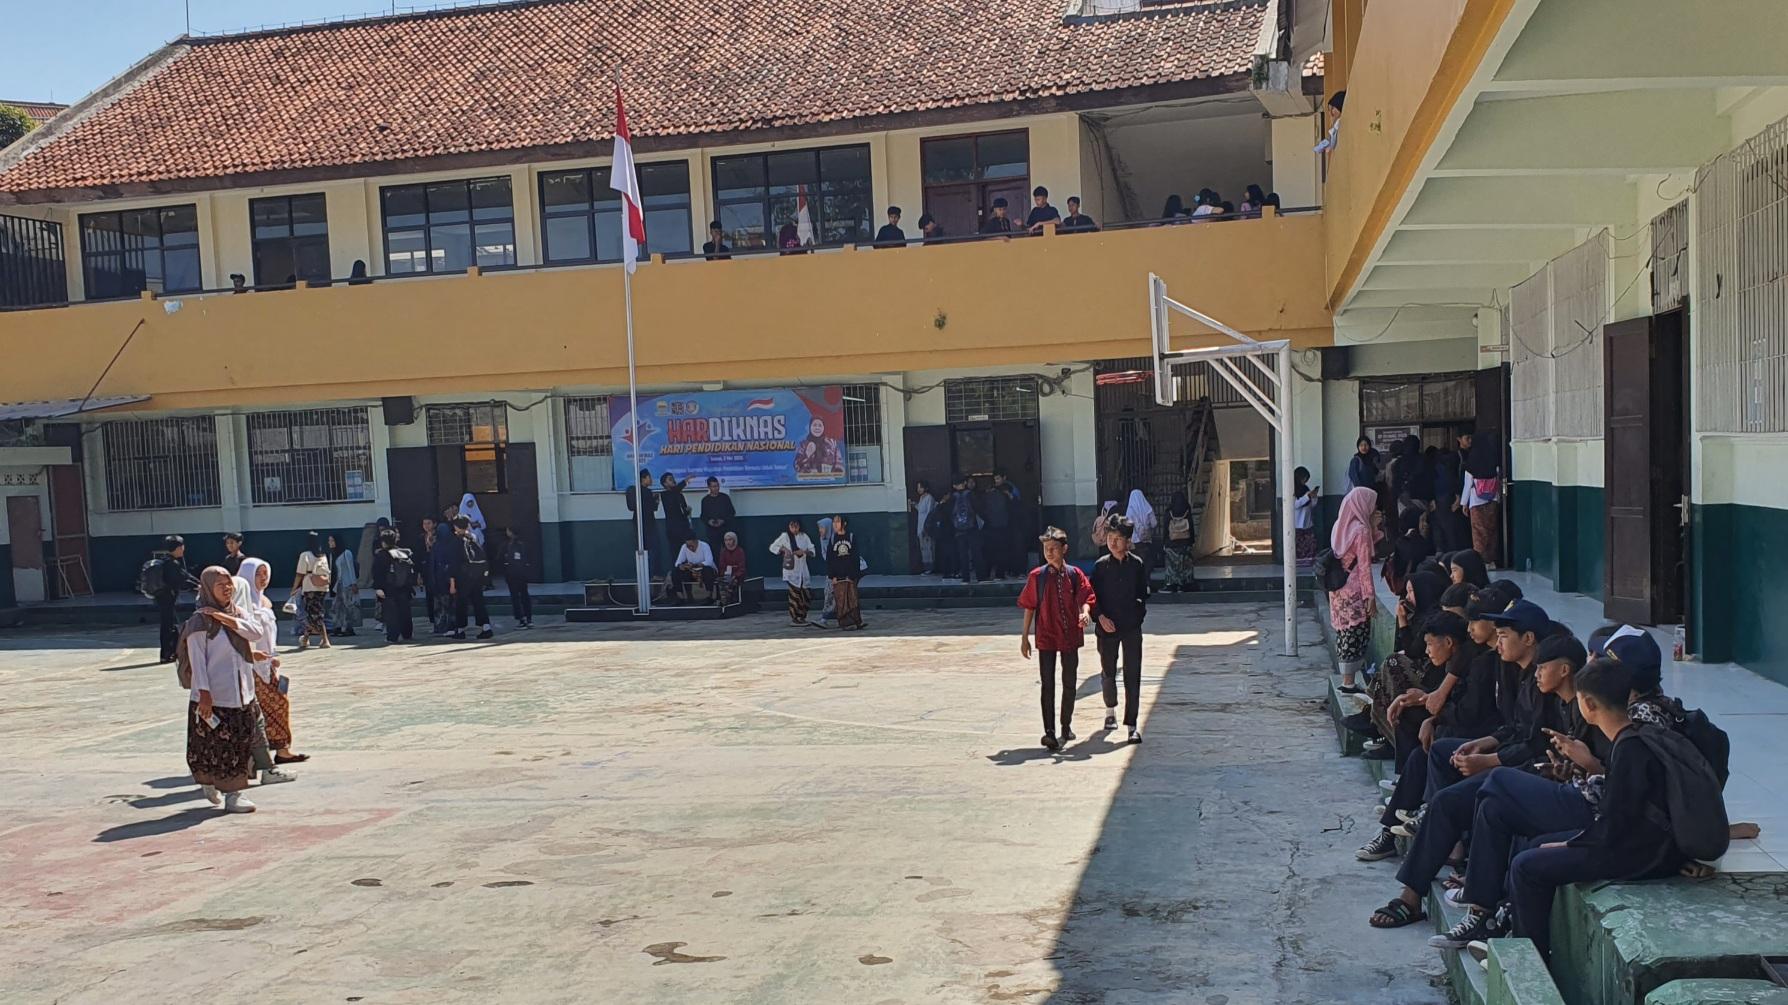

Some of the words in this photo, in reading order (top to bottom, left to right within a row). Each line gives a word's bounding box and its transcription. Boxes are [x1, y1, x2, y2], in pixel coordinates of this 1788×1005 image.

[668, 415, 786, 443] HARDIKNAS
[660, 442, 685, 455] HARI
[685, 441, 745, 454] PENDIDIKAN
[746, 440, 796, 452] NASIONAL
